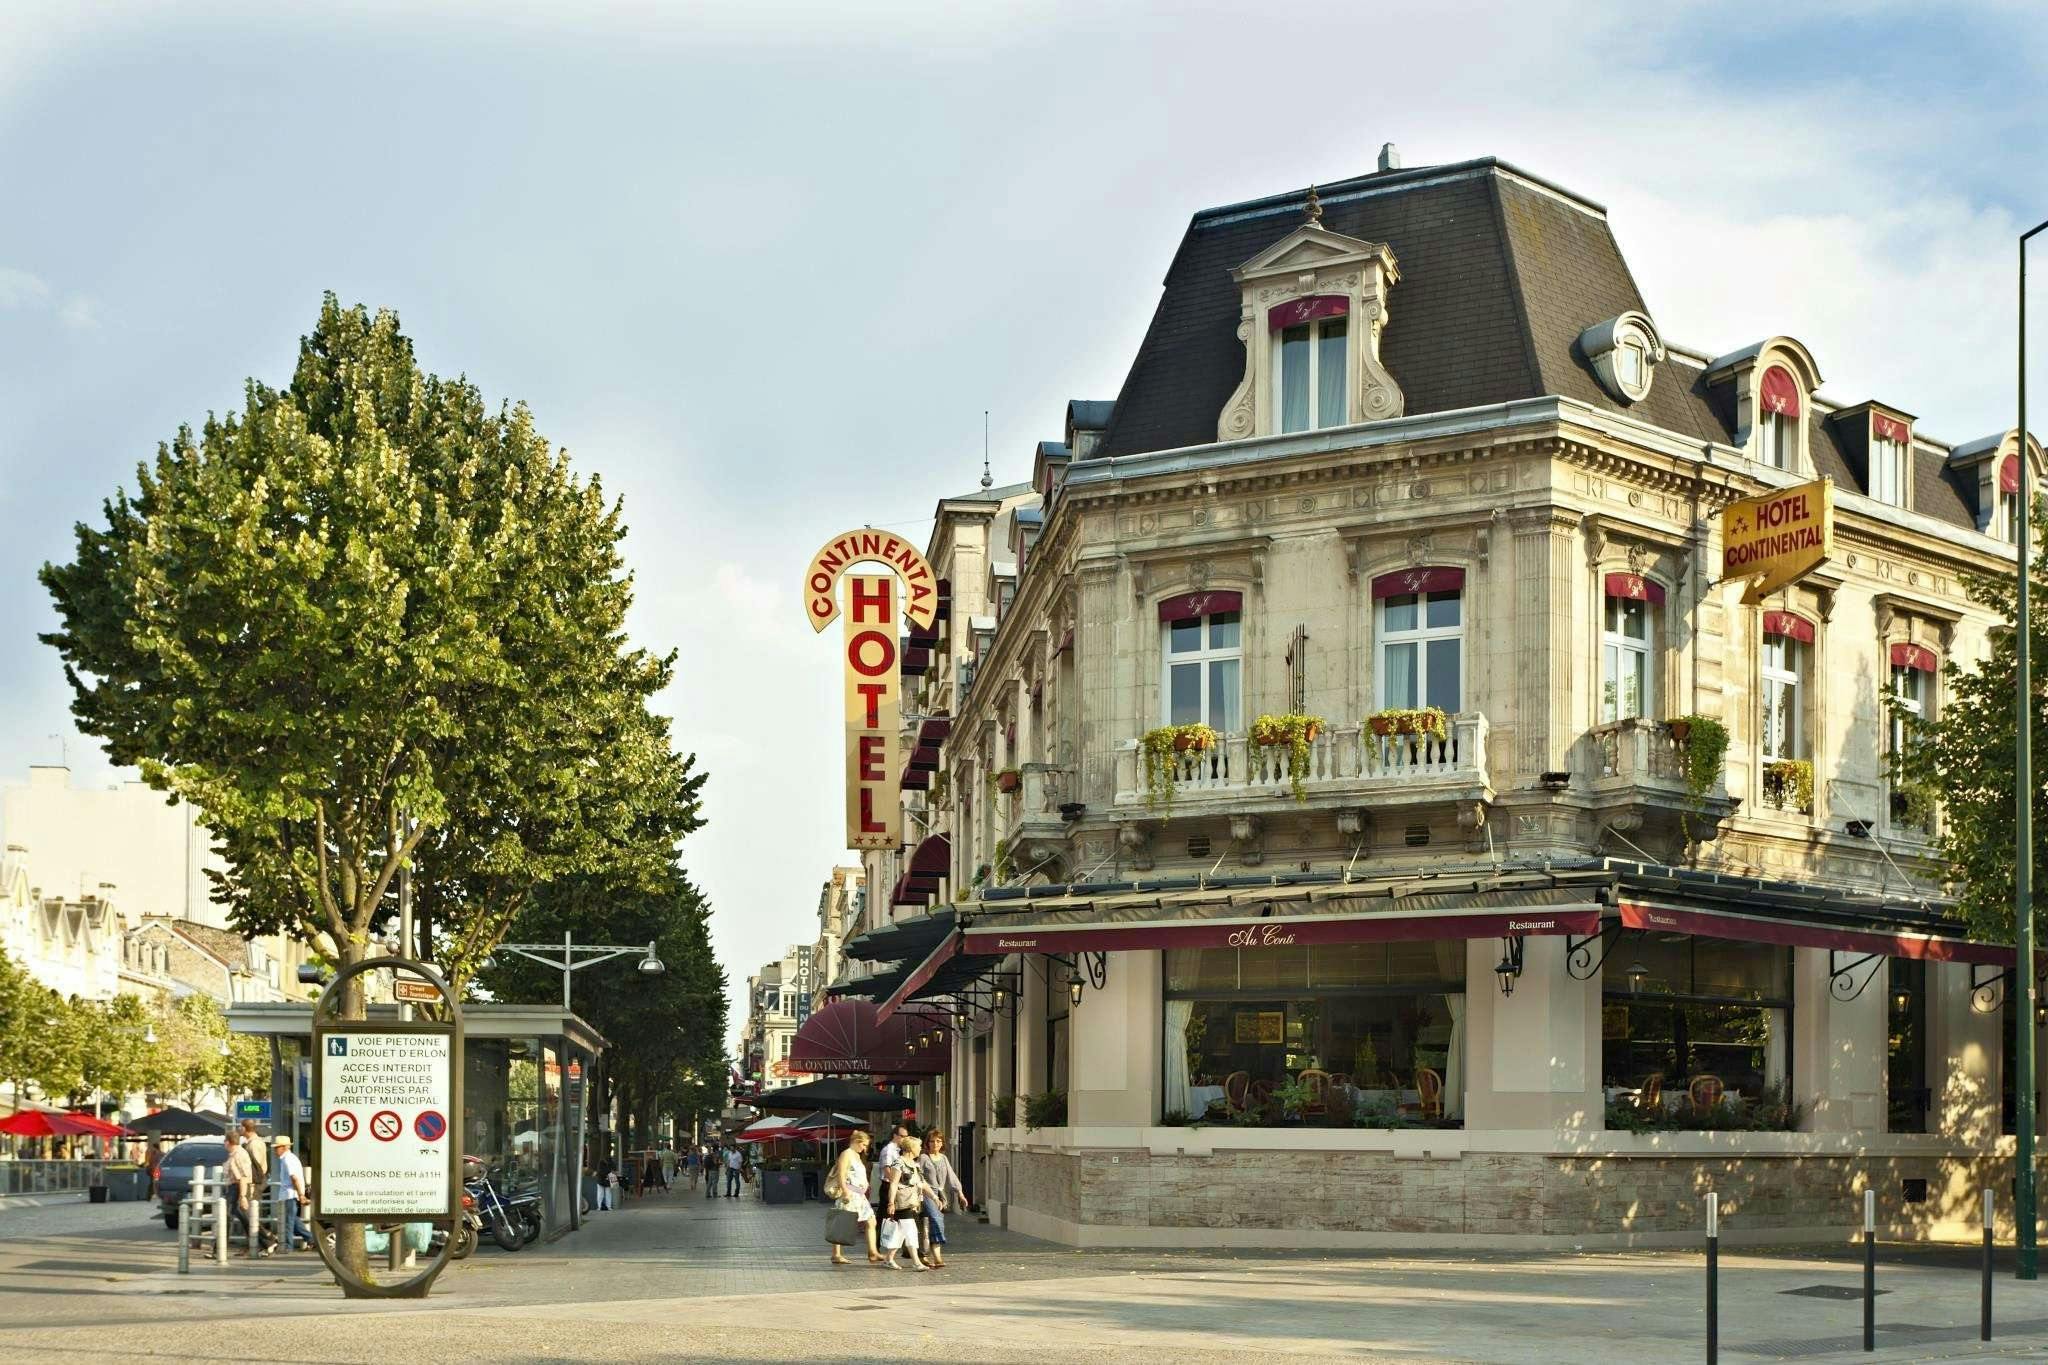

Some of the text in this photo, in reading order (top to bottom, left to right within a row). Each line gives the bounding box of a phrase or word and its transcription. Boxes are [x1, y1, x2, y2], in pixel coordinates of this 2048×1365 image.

[1757, 495, 1809, 531] HOTEL
[1727, 525, 1822, 567] CONTINENTAL
[811, 534, 931, 617] CONTINENTAL
[848, 578, 895, 833] HOTEL
[1509, 920, 1555, 930] Restaurant
[1228, 925, 1296, 946] Au Conti
[998, 939, 1037, 947] Restaurant
[799, 958, 809, 1003] HOTEL
[357, 1038, 440, 1046] VOIE PIETONNE
[351, 1049, 395, 1057] DROUET
[342, 1064, 432, 1072] ACCES INTERDIT
[805, 1059, 871, 1070] CONTINENTAL
[340, 1075, 433, 1084] SAUF VEHICULES
[343, 1086, 429, 1094] AUTORISES PAR
[333, 1096, 440, 1105] ARRETE MUNICIPAL
[333, 1120, 350, 1132] 15
[330, 1170, 386, 1178] LIVRAISONS
[389, 1170, 401, 1178] DE
